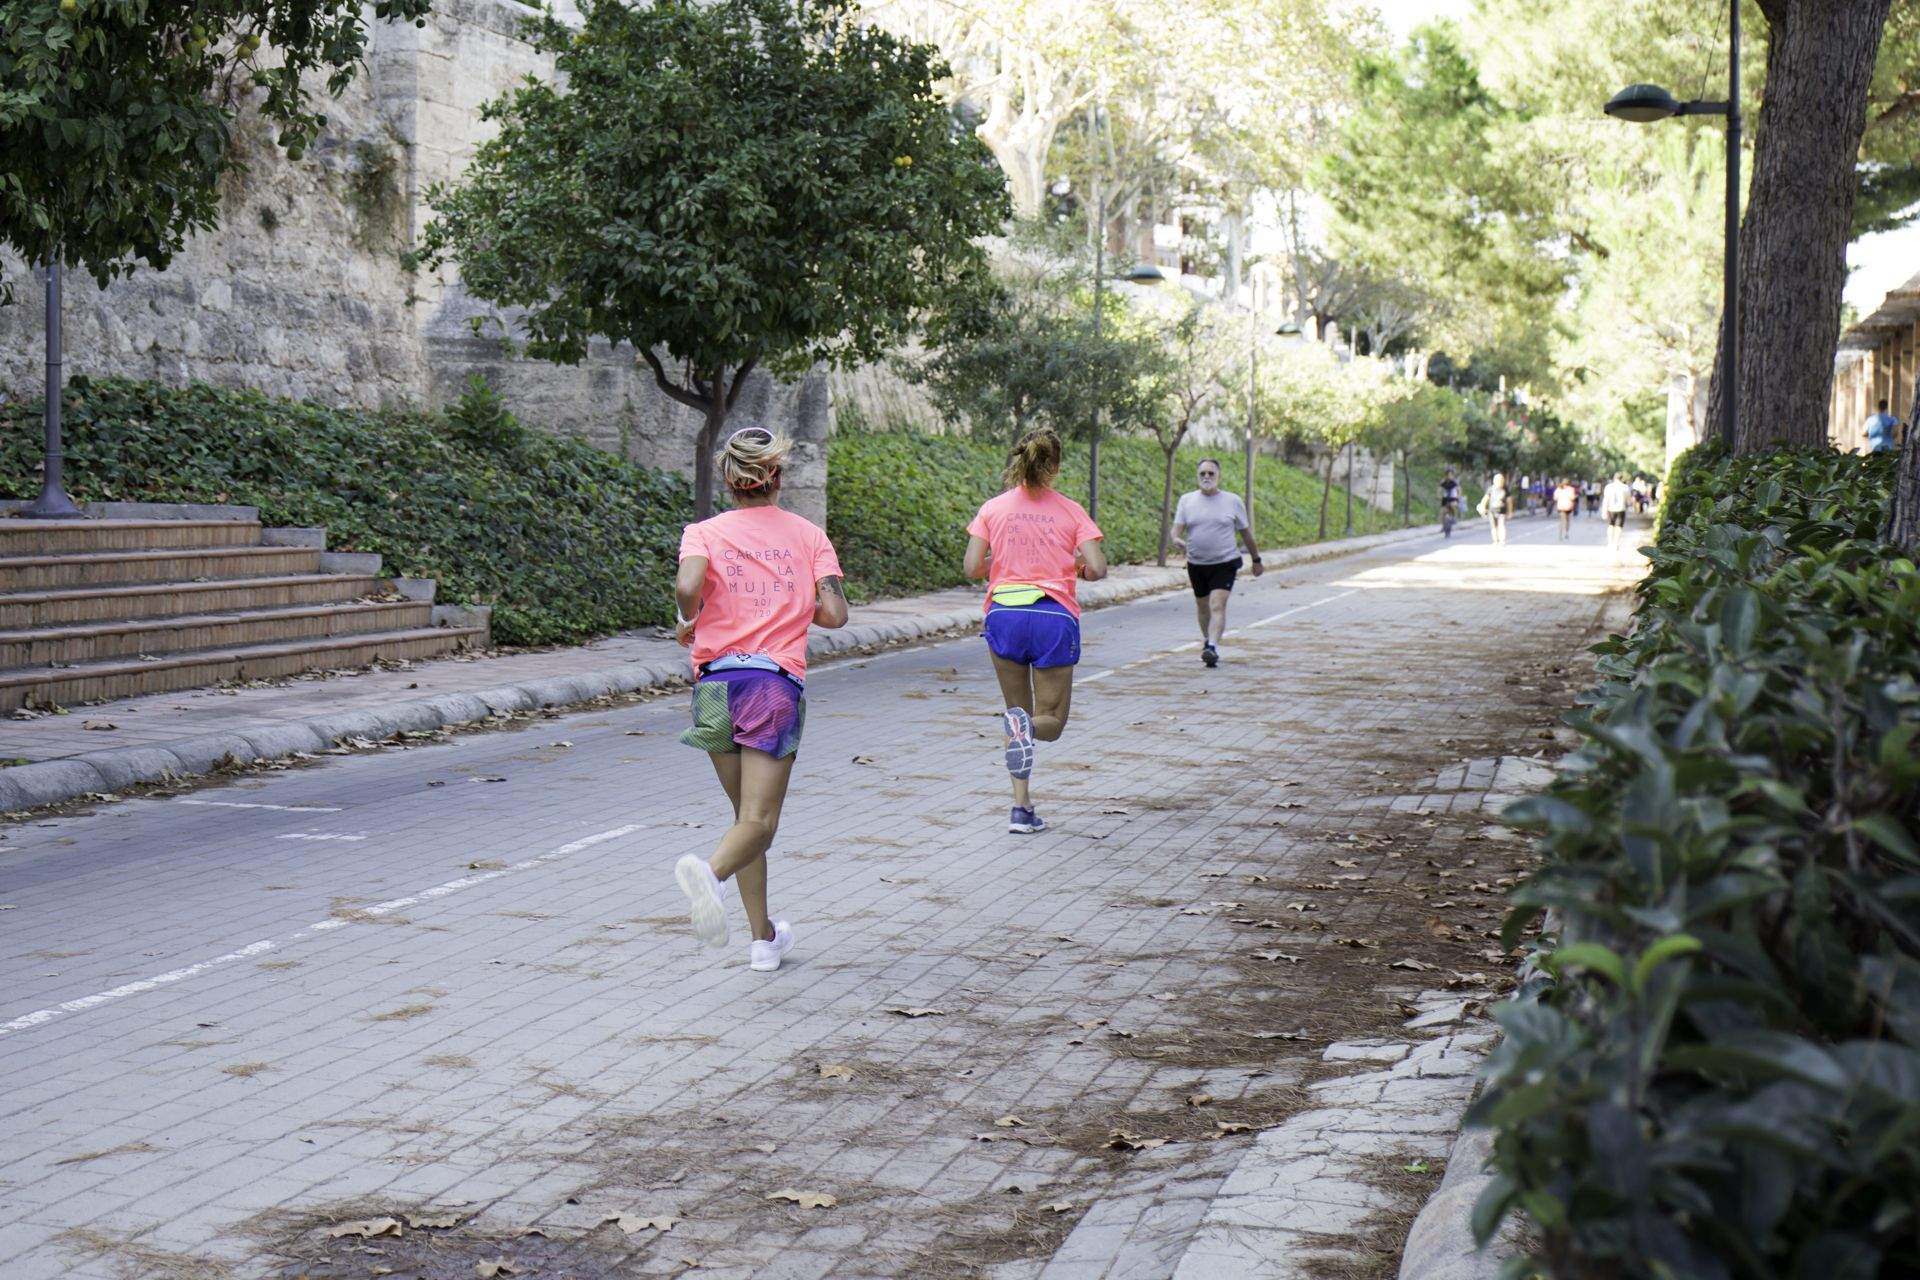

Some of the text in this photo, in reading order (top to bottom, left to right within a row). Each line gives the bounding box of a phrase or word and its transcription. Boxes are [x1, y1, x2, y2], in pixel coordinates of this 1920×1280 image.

[1007, 512, 1055, 523] CARRERA
[1007, 525, 1055, 535] DE LA
[724, 548, 792, 561] CARRERA
[726, 565, 794, 576] DE LA
[729, 581, 795, 595] MUJER
